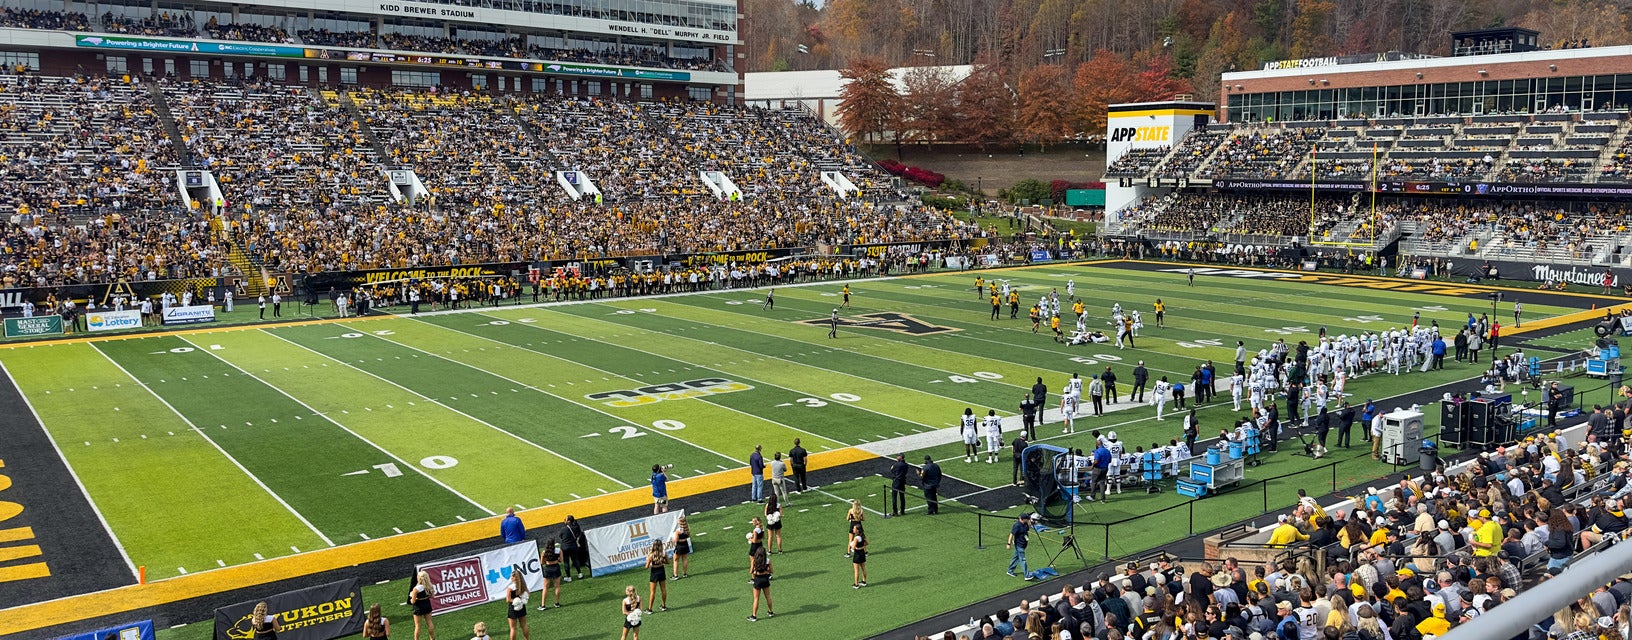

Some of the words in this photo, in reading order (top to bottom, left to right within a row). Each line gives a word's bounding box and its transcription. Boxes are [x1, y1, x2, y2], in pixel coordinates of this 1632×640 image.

[404, 6, 437, 15] BREWER
[441, 9, 474, 18] STADIUM
[608, 24, 638, 33] WENDELL
[106, 39, 137, 48] Powering
[746, 252, 768, 262] ROCK
[451, 267, 482, 279] ROCK
[1532, 265, 1618, 286] Mountainees
[106, 317, 139, 327] Lottery
[1074, 381, 1080, 389] 10
[617, 544, 631, 552] LAW
[608, 548, 639, 564] TIMOTHY
[441, 565, 476, 581] FARM
[513, 558, 540, 577] NC
[432, 576, 479, 595] BUREAU
[440, 590, 481, 605] INSURANCE
[1306, 613, 1318, 626] 20
